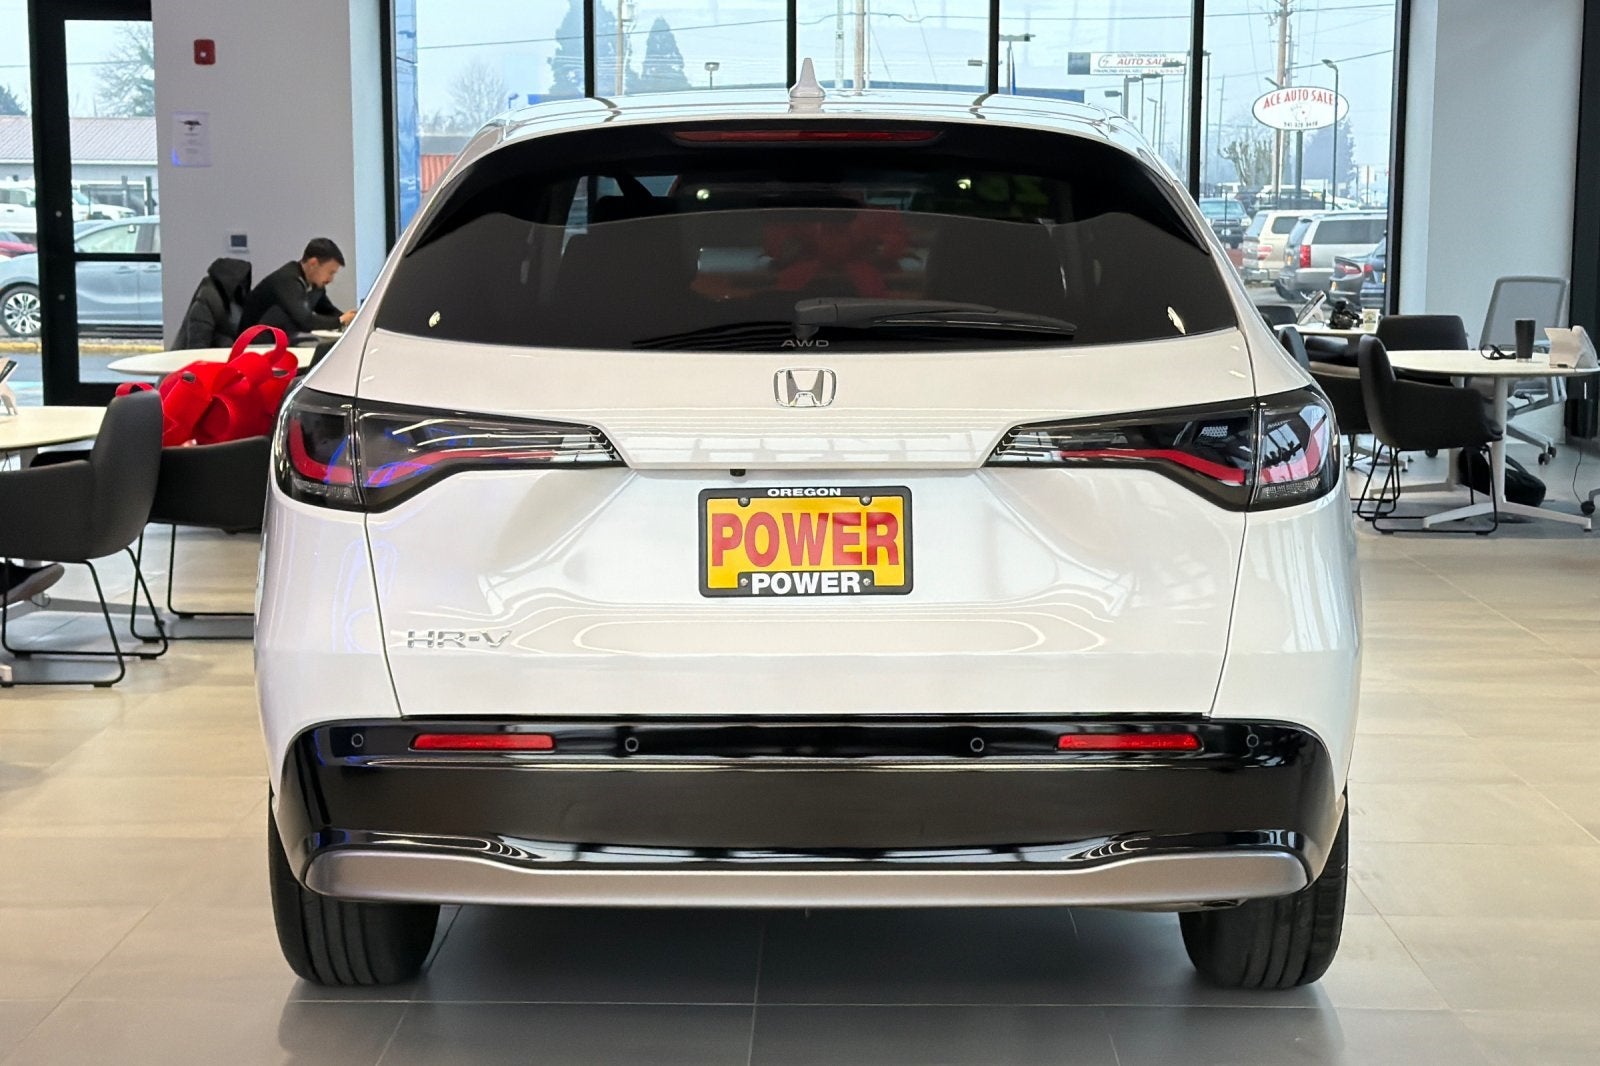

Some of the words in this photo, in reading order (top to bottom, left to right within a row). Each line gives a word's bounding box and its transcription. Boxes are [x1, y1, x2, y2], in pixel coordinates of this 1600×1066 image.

[1117, 58, 1144, 66] AUTO
[1263, 92, 1281, 109] ACE
[1283, 88, 1309, 102] AUTO
[781, 339, 830, 348] AWD
[767, 487, 842, 498] OREGON
[711, 511, 900, 568] POWER
[751, 571, 861, 595] POWER
[407, 630, 512, 649] HR-V
